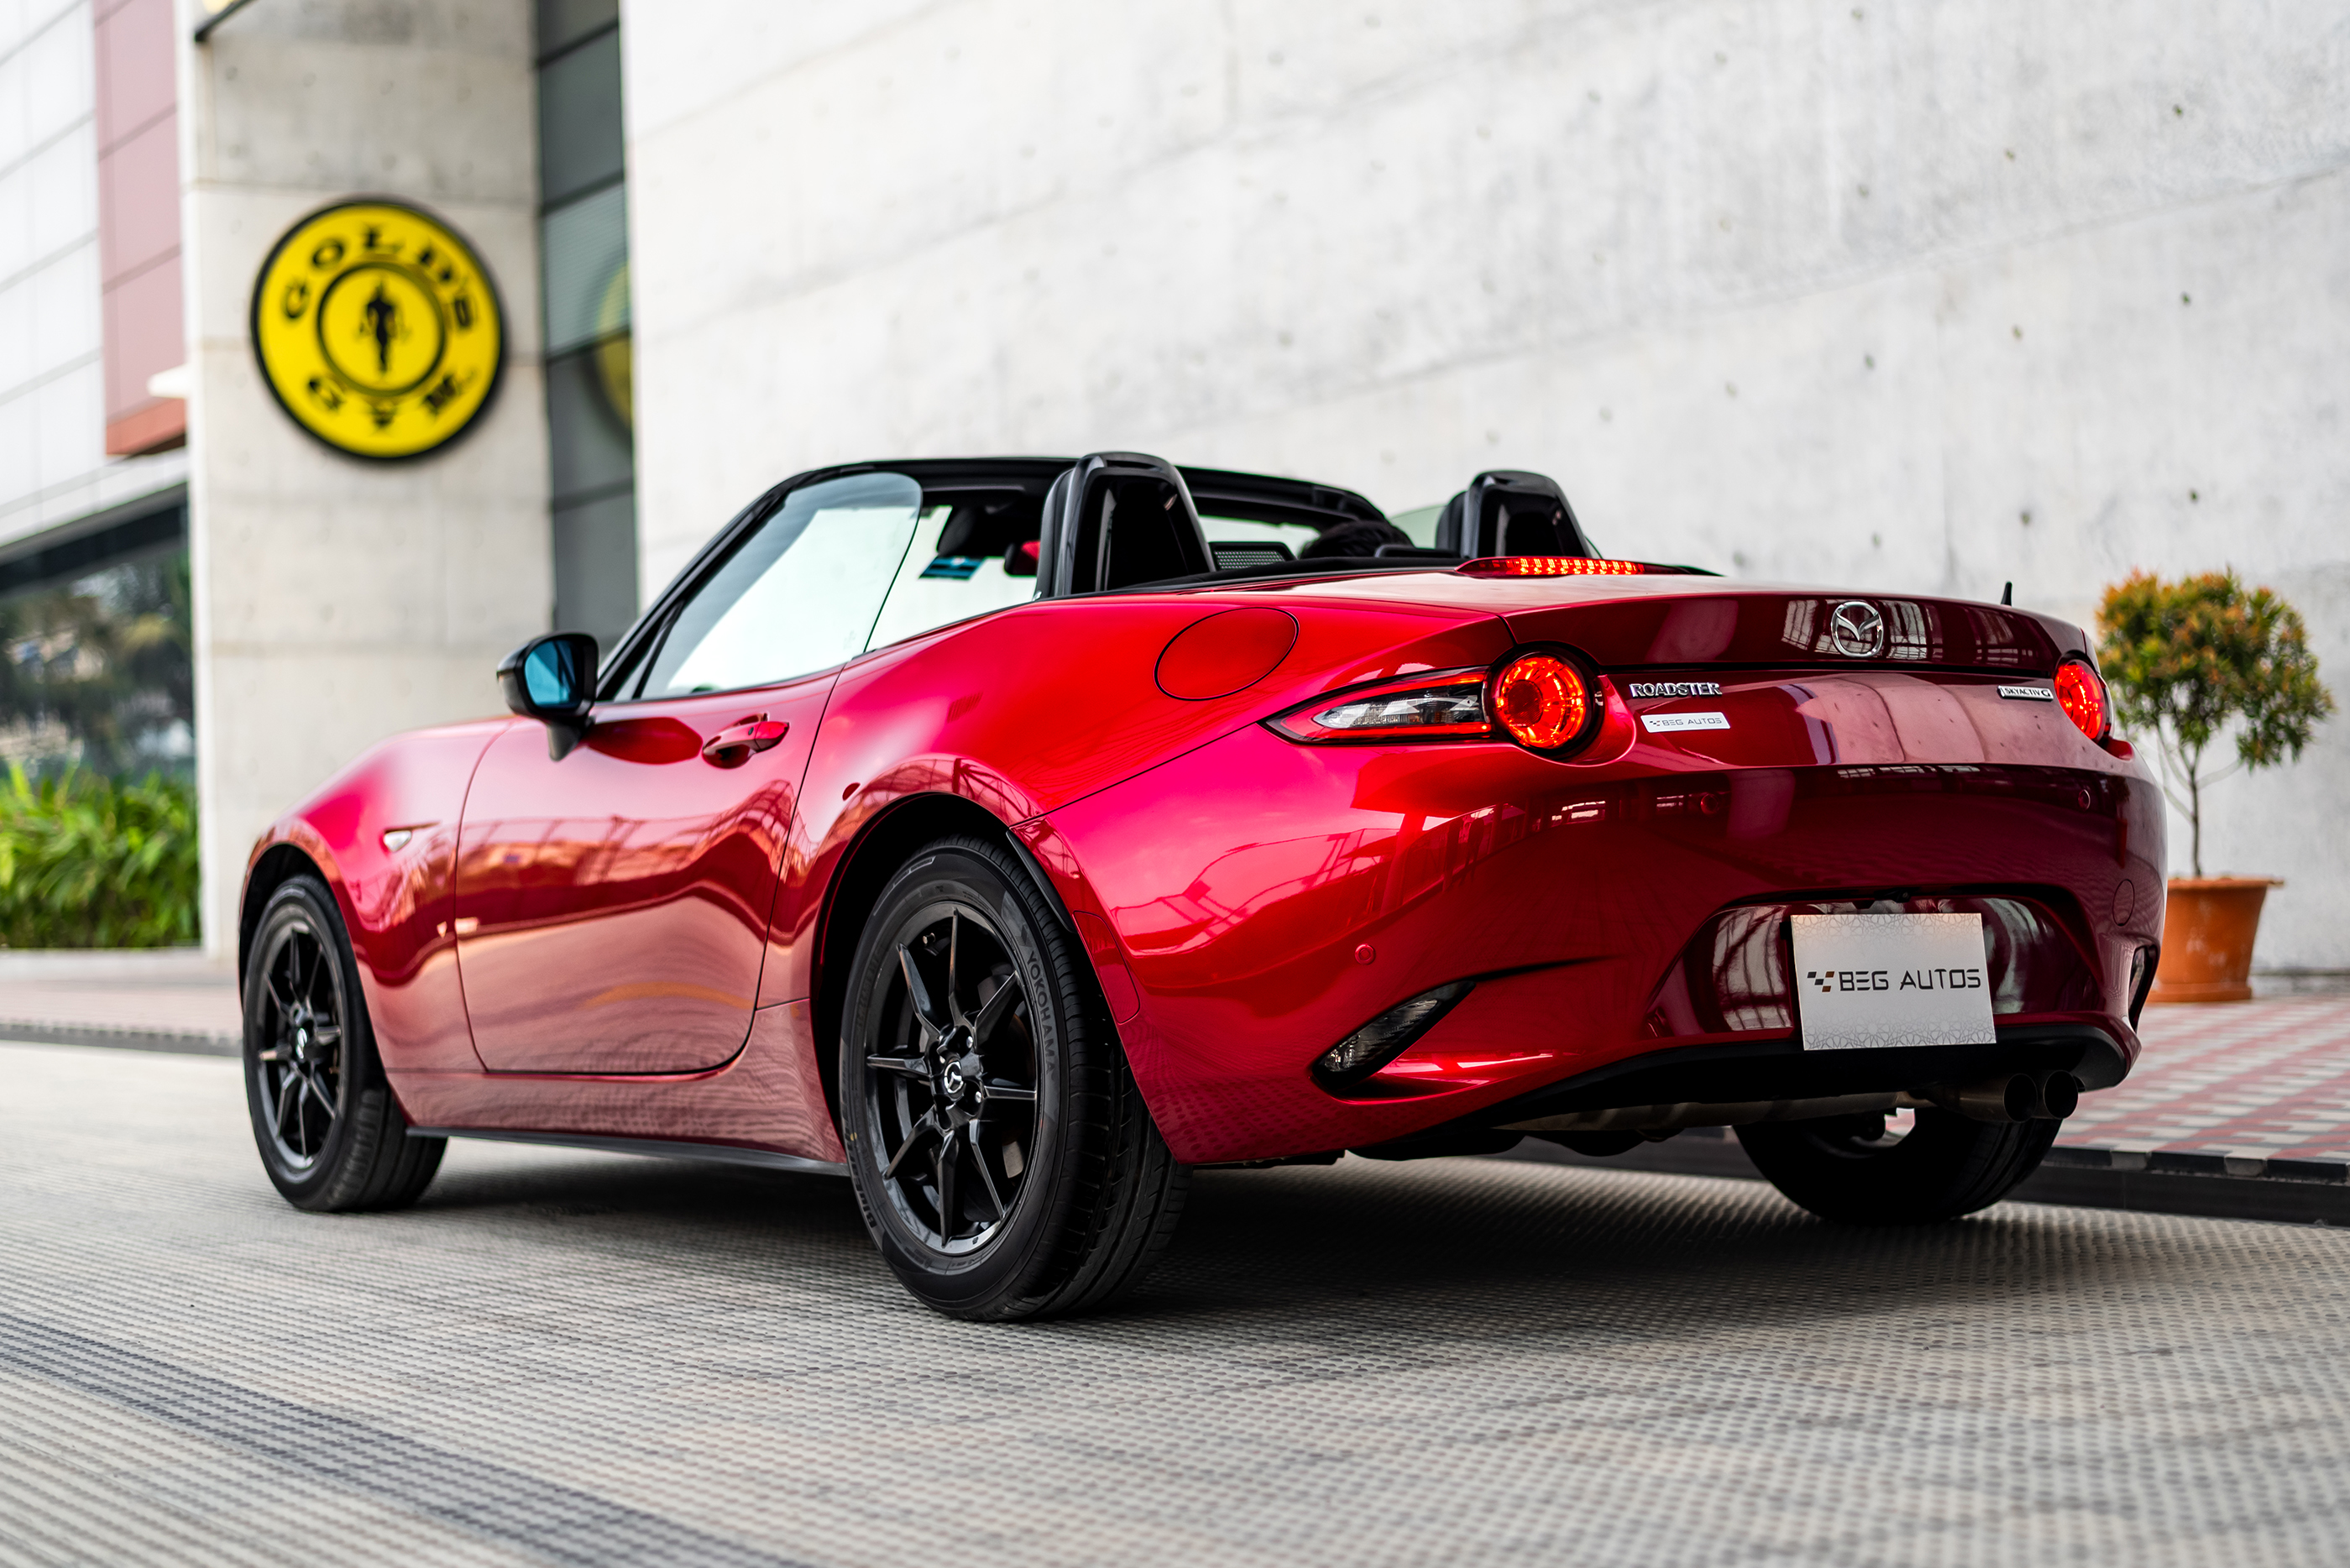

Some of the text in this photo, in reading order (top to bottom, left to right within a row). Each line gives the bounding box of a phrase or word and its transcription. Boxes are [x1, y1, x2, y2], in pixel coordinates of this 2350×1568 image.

[1629, 682, 1723, 698] ROADSTER
[1839, 969, 1981, 991] BEG AUTOS
[1027, 950, 1056, 1075] YOKOHAMA
